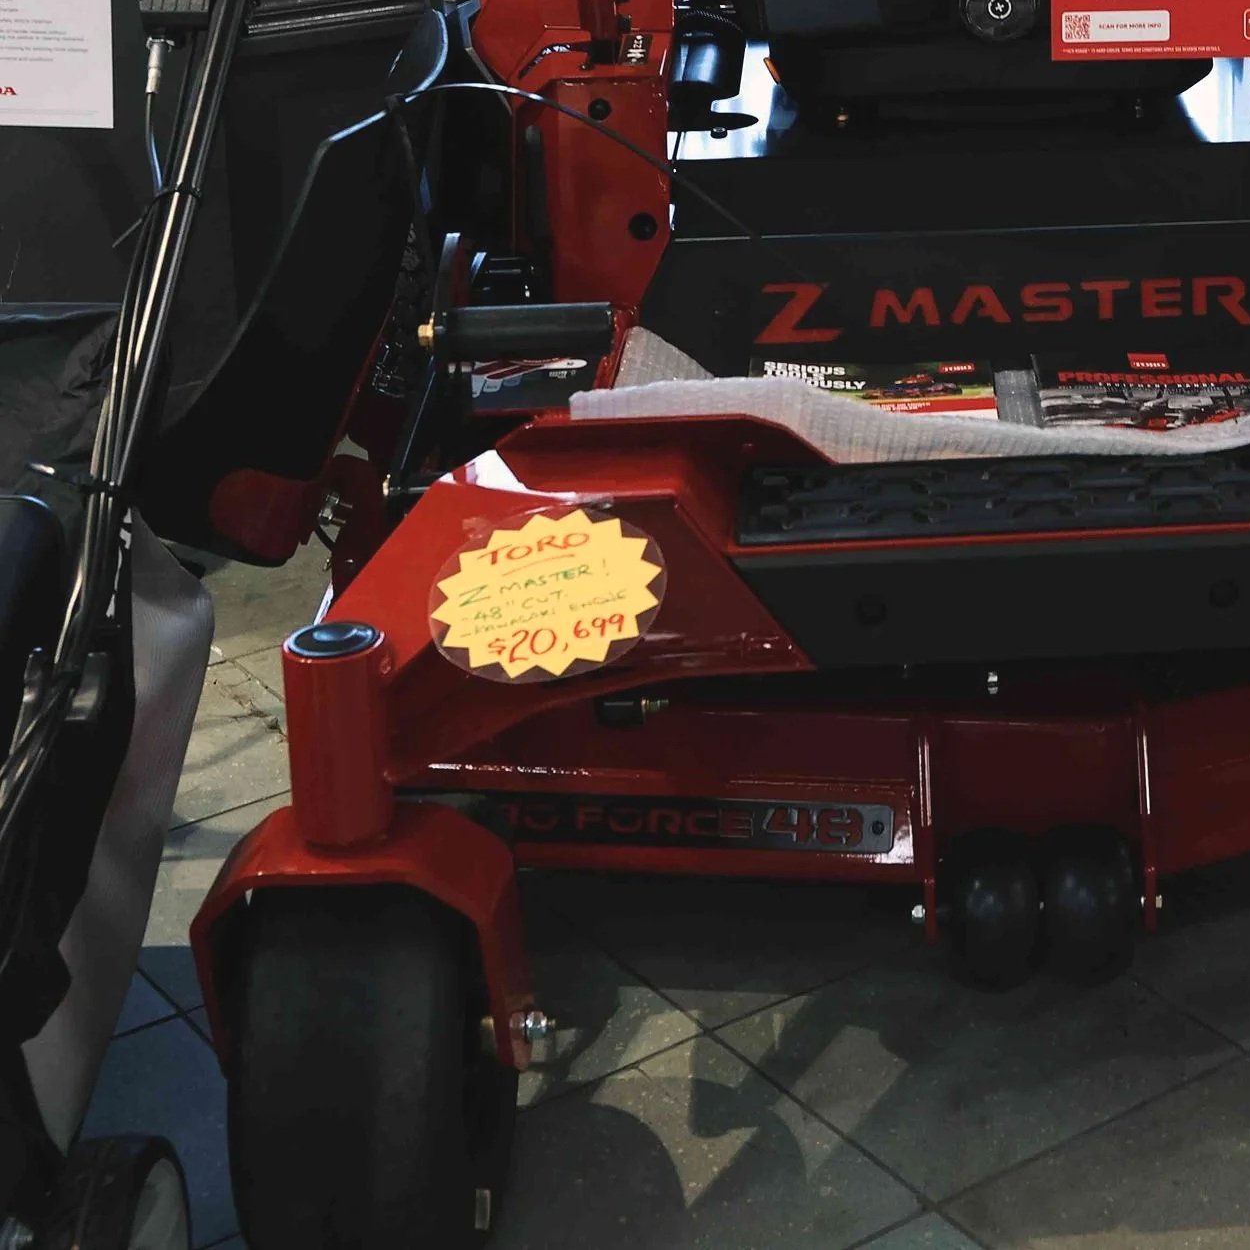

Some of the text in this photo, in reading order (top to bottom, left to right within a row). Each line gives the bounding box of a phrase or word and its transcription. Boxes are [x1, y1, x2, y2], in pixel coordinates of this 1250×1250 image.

[753, 282, 844, 345] Z
[764, 361, 846, 376] SERIOUS
[477, 532, 590, 566] TORO
[458, 584, 492, 608] Z
[499, 564, 592, 596] MASTER
[487, 613, 625, 664] $20,699
[573, 805, 756, 840] FORCE
[762, 805, 866, 846] 48
